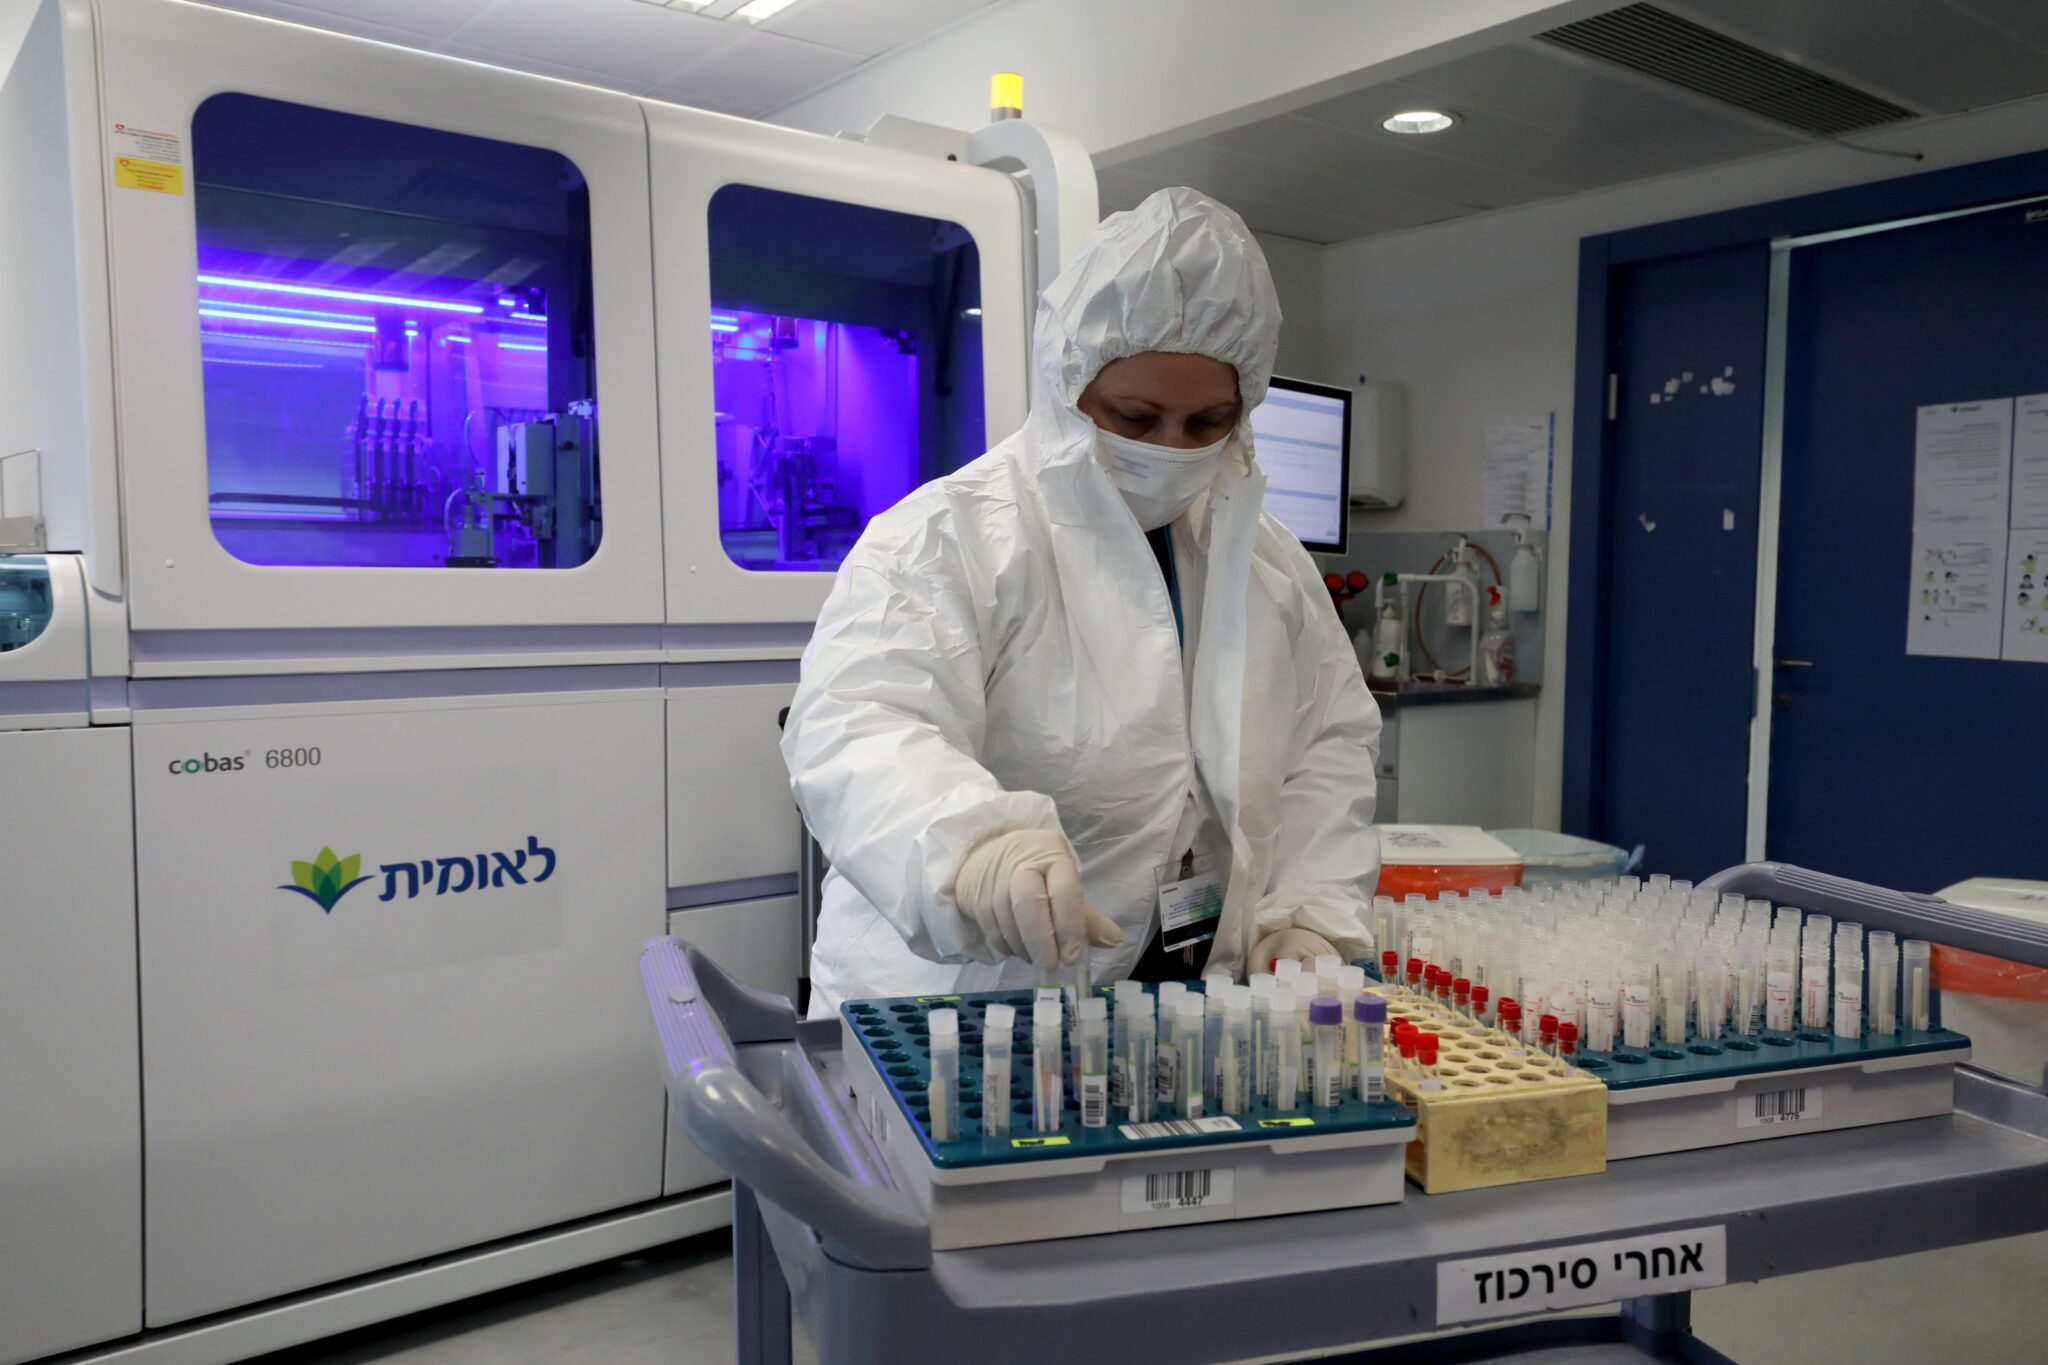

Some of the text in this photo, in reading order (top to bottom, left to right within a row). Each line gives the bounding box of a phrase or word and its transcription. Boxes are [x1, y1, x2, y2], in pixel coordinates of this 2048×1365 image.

[265, 747, 321, 769] 6800
[378, 836, 556, 902] לאומית
[1178, 1195, 1204, 1207] 4447
[1475, 1243, 1704, 1304] אחרי סירכוז
